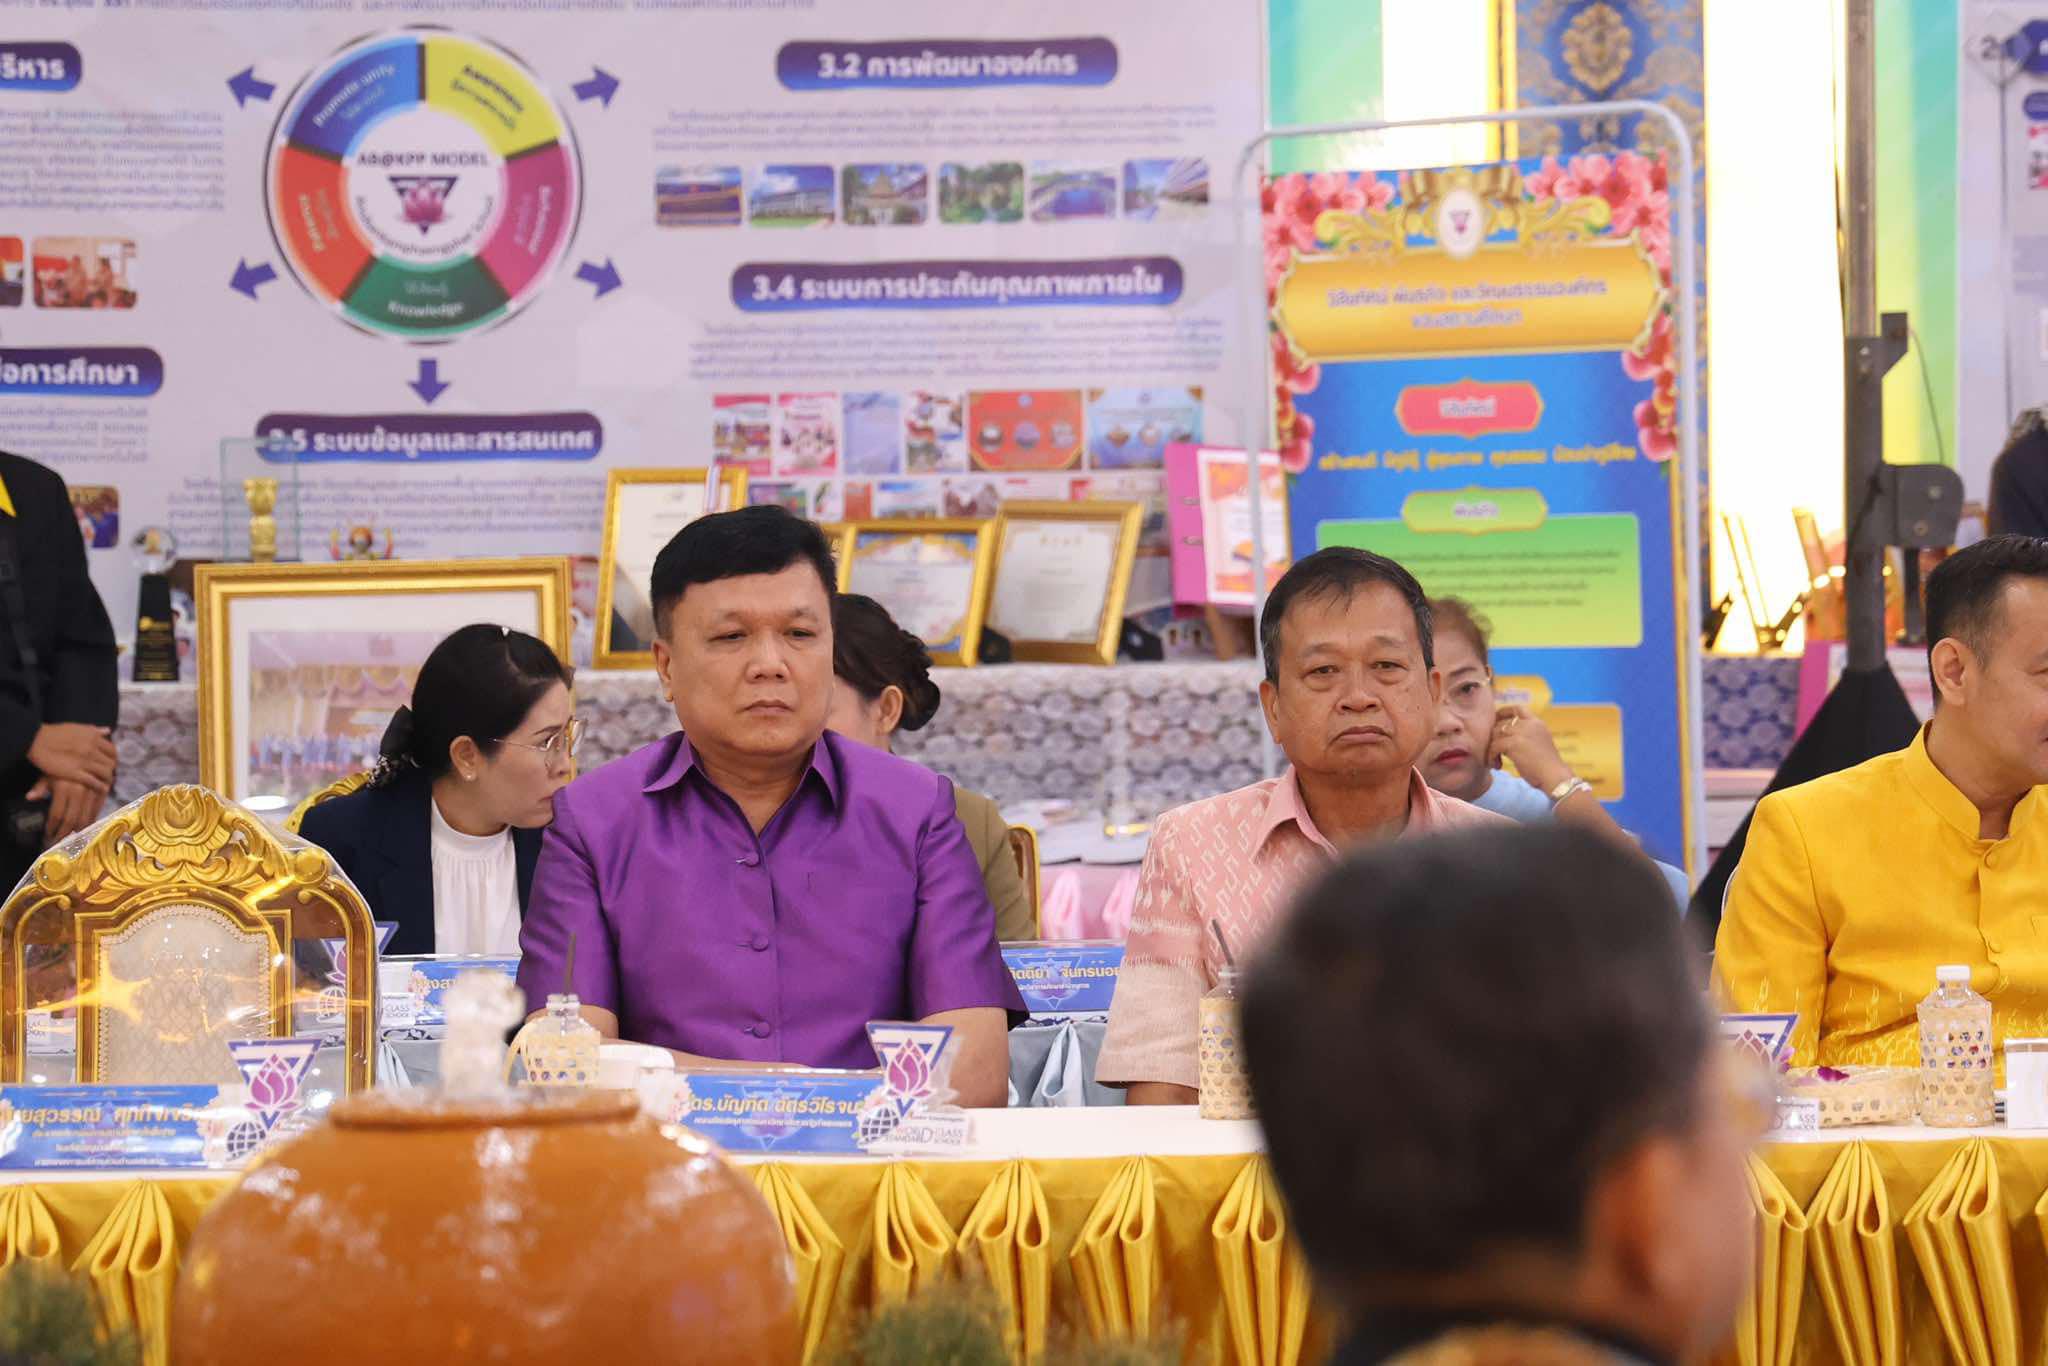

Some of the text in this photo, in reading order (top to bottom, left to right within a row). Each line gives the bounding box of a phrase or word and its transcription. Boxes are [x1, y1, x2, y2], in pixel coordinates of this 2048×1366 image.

[0, 52, 66, 80] ริหาร
[817, 48, 1078, 79] 3.2 การพัฒนาองค์กร
[430, 153, 488, 167] MODEL
[752, 266, 1163, 304] 3.4 ระบบการประกันคุณภาพภายใน
[313, 425, 594, 458] ระบบข้อมูลและสารสนเทศ
